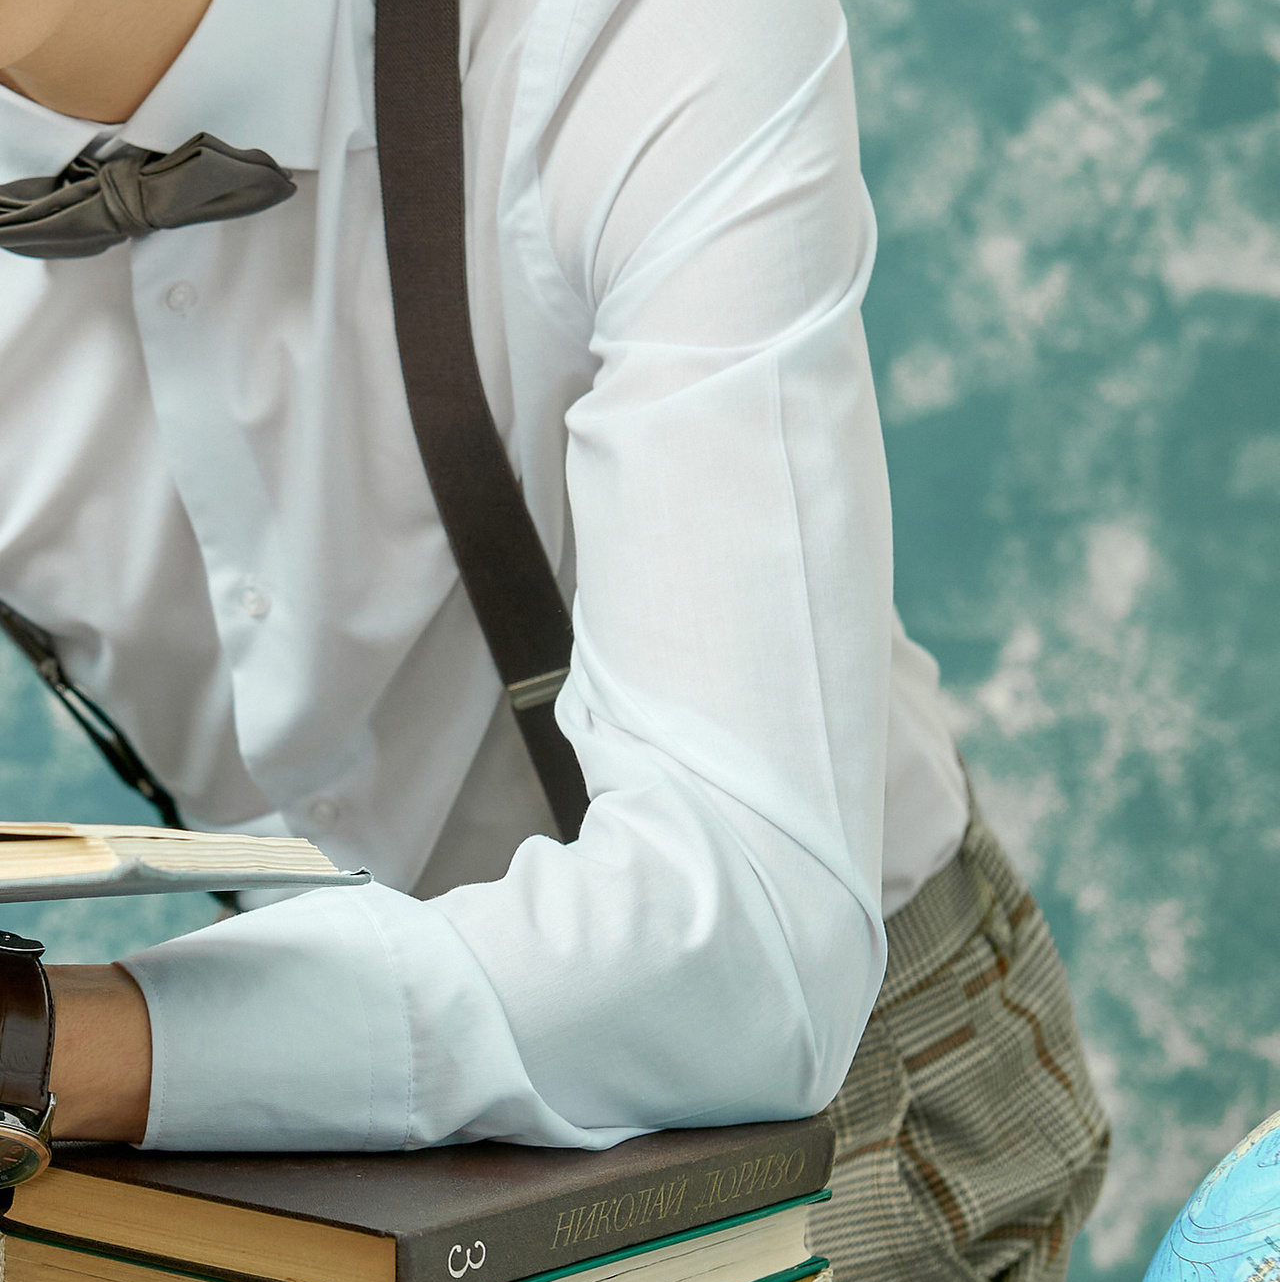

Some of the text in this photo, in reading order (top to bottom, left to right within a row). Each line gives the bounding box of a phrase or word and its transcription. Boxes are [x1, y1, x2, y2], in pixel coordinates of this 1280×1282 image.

[550, 1147, 806, 1250] НИКОЛАЙ ДОРИЗО
[448, 1240, 486, 1279] 3
